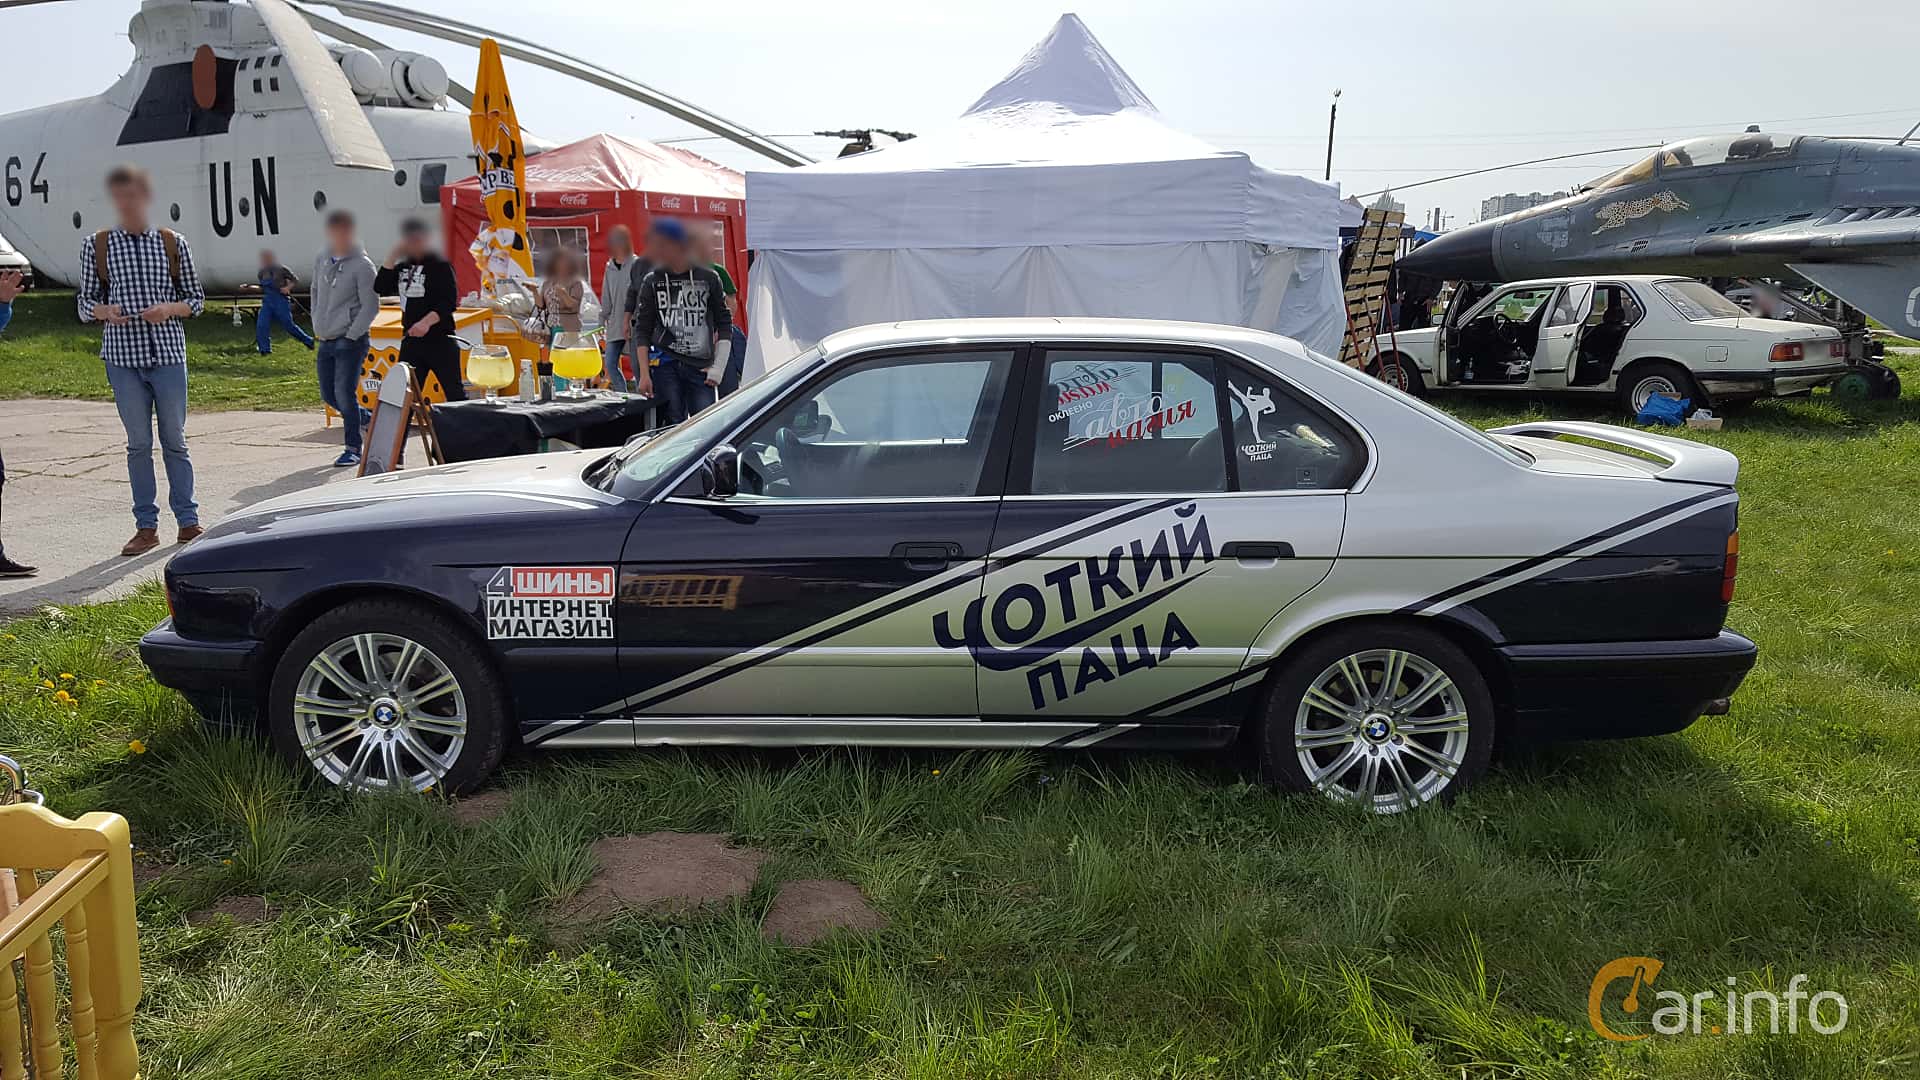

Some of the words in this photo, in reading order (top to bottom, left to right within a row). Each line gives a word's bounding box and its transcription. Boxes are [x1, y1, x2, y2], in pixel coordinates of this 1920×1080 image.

[5, 151, 49, 207] 64
[656, 290, 707, 309] BLACK
[658, 309, 705, 328] WHITE
[1048, 400, 1094, 423] ОКЛЕЕНО
[1241, 441, 1277, 456] ЧОТКИЙ
[1250, 454, 1273, 463] ПАЦА
[932, 503, 1215, 671] ЧОТКИЙ
[489, 599, 611, 619] ИНТЕРНЕТ
[489, 619, 613, 638] МАГАЗИН
[1026, 611, 1200, 710] ПАЦА
